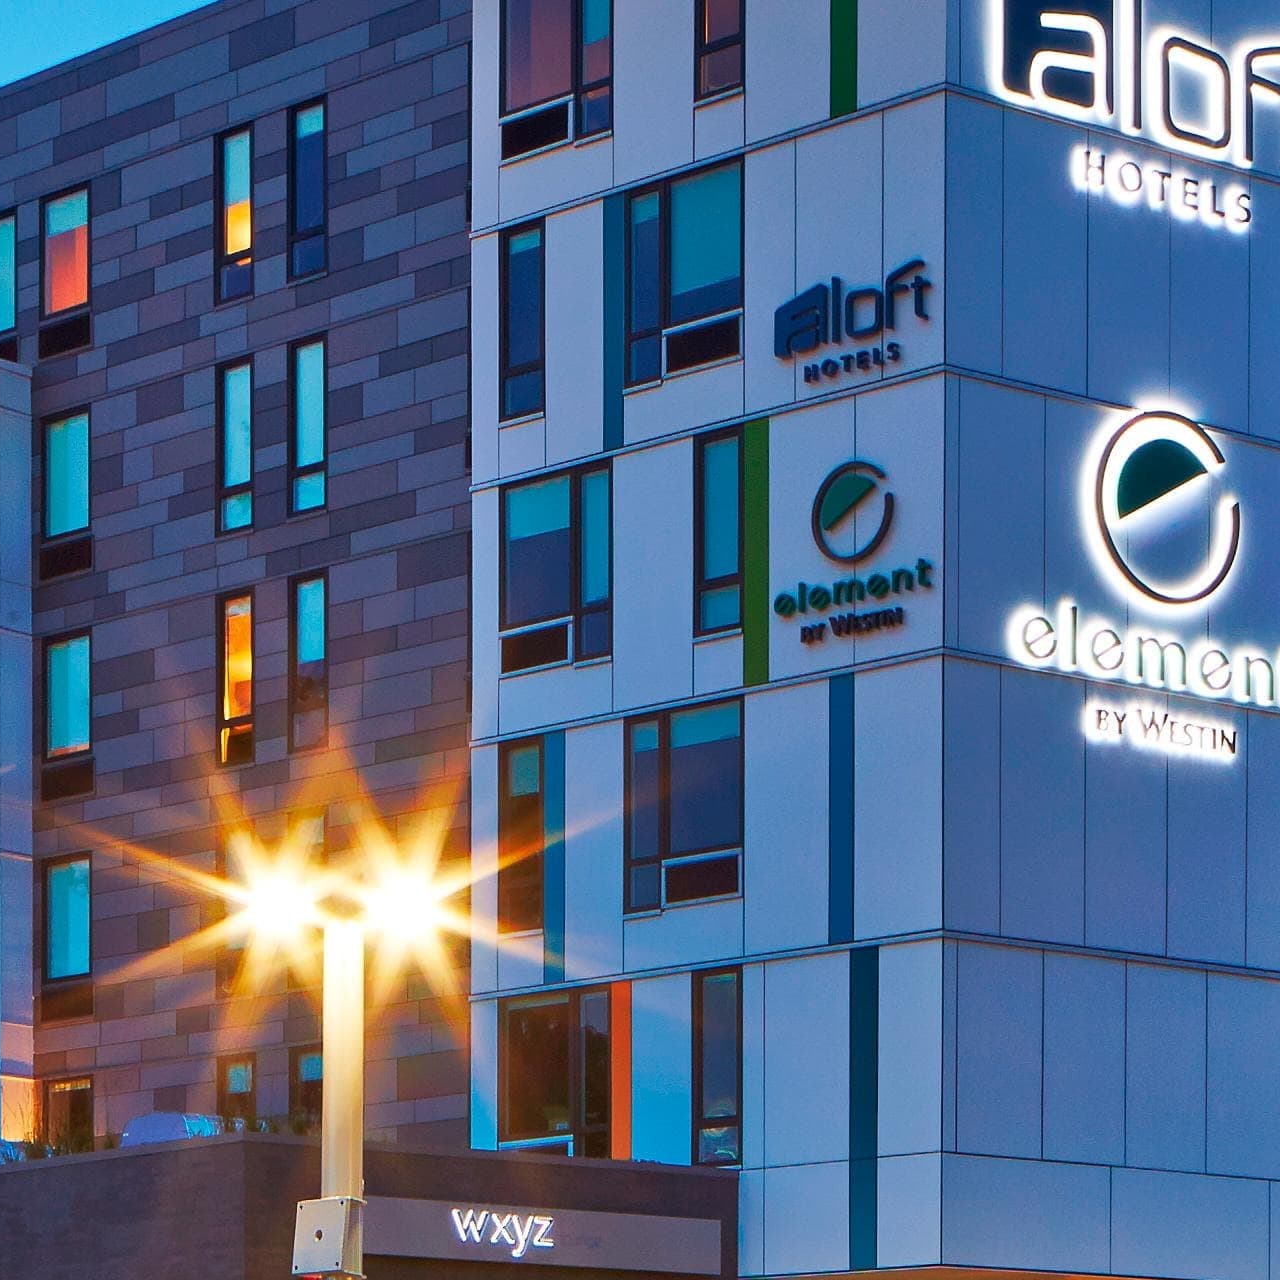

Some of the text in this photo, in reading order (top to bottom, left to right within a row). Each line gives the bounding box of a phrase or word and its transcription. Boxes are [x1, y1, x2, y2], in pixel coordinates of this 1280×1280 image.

[1078, 148, 1253, 225] HOTELS
[773, 258, 933, 360] aloft
[803, 341, 901, 384] HOTELS
[772, 557, 933, 618] element
[1093, 706, 1128, 736] BY
